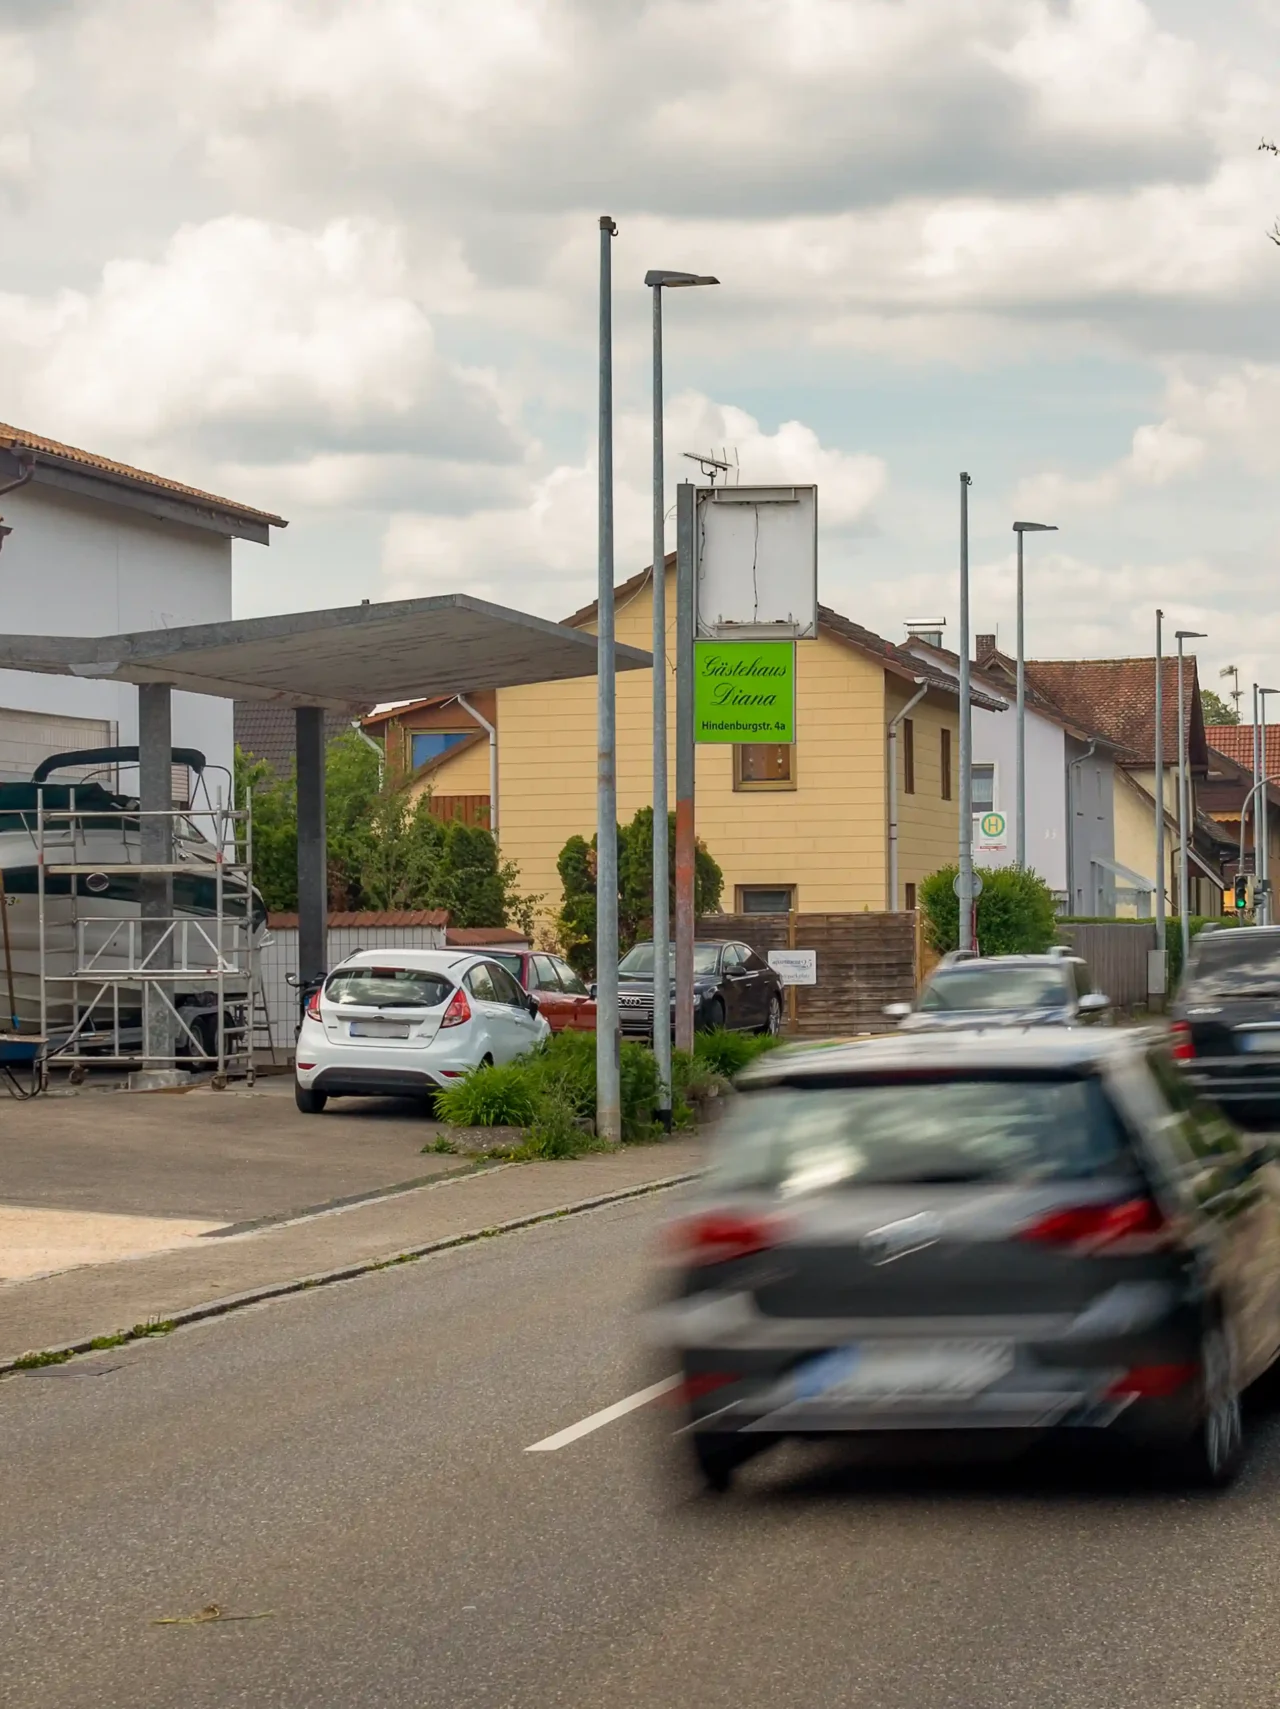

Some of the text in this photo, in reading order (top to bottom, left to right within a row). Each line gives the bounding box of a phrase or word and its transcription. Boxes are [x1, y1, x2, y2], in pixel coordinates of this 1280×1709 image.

[702, 655, 787, 677] Gästehaus
[710, 682, 777, 706] Diana
[702, 721, 786, 732] Hindenburgstr. 4a
